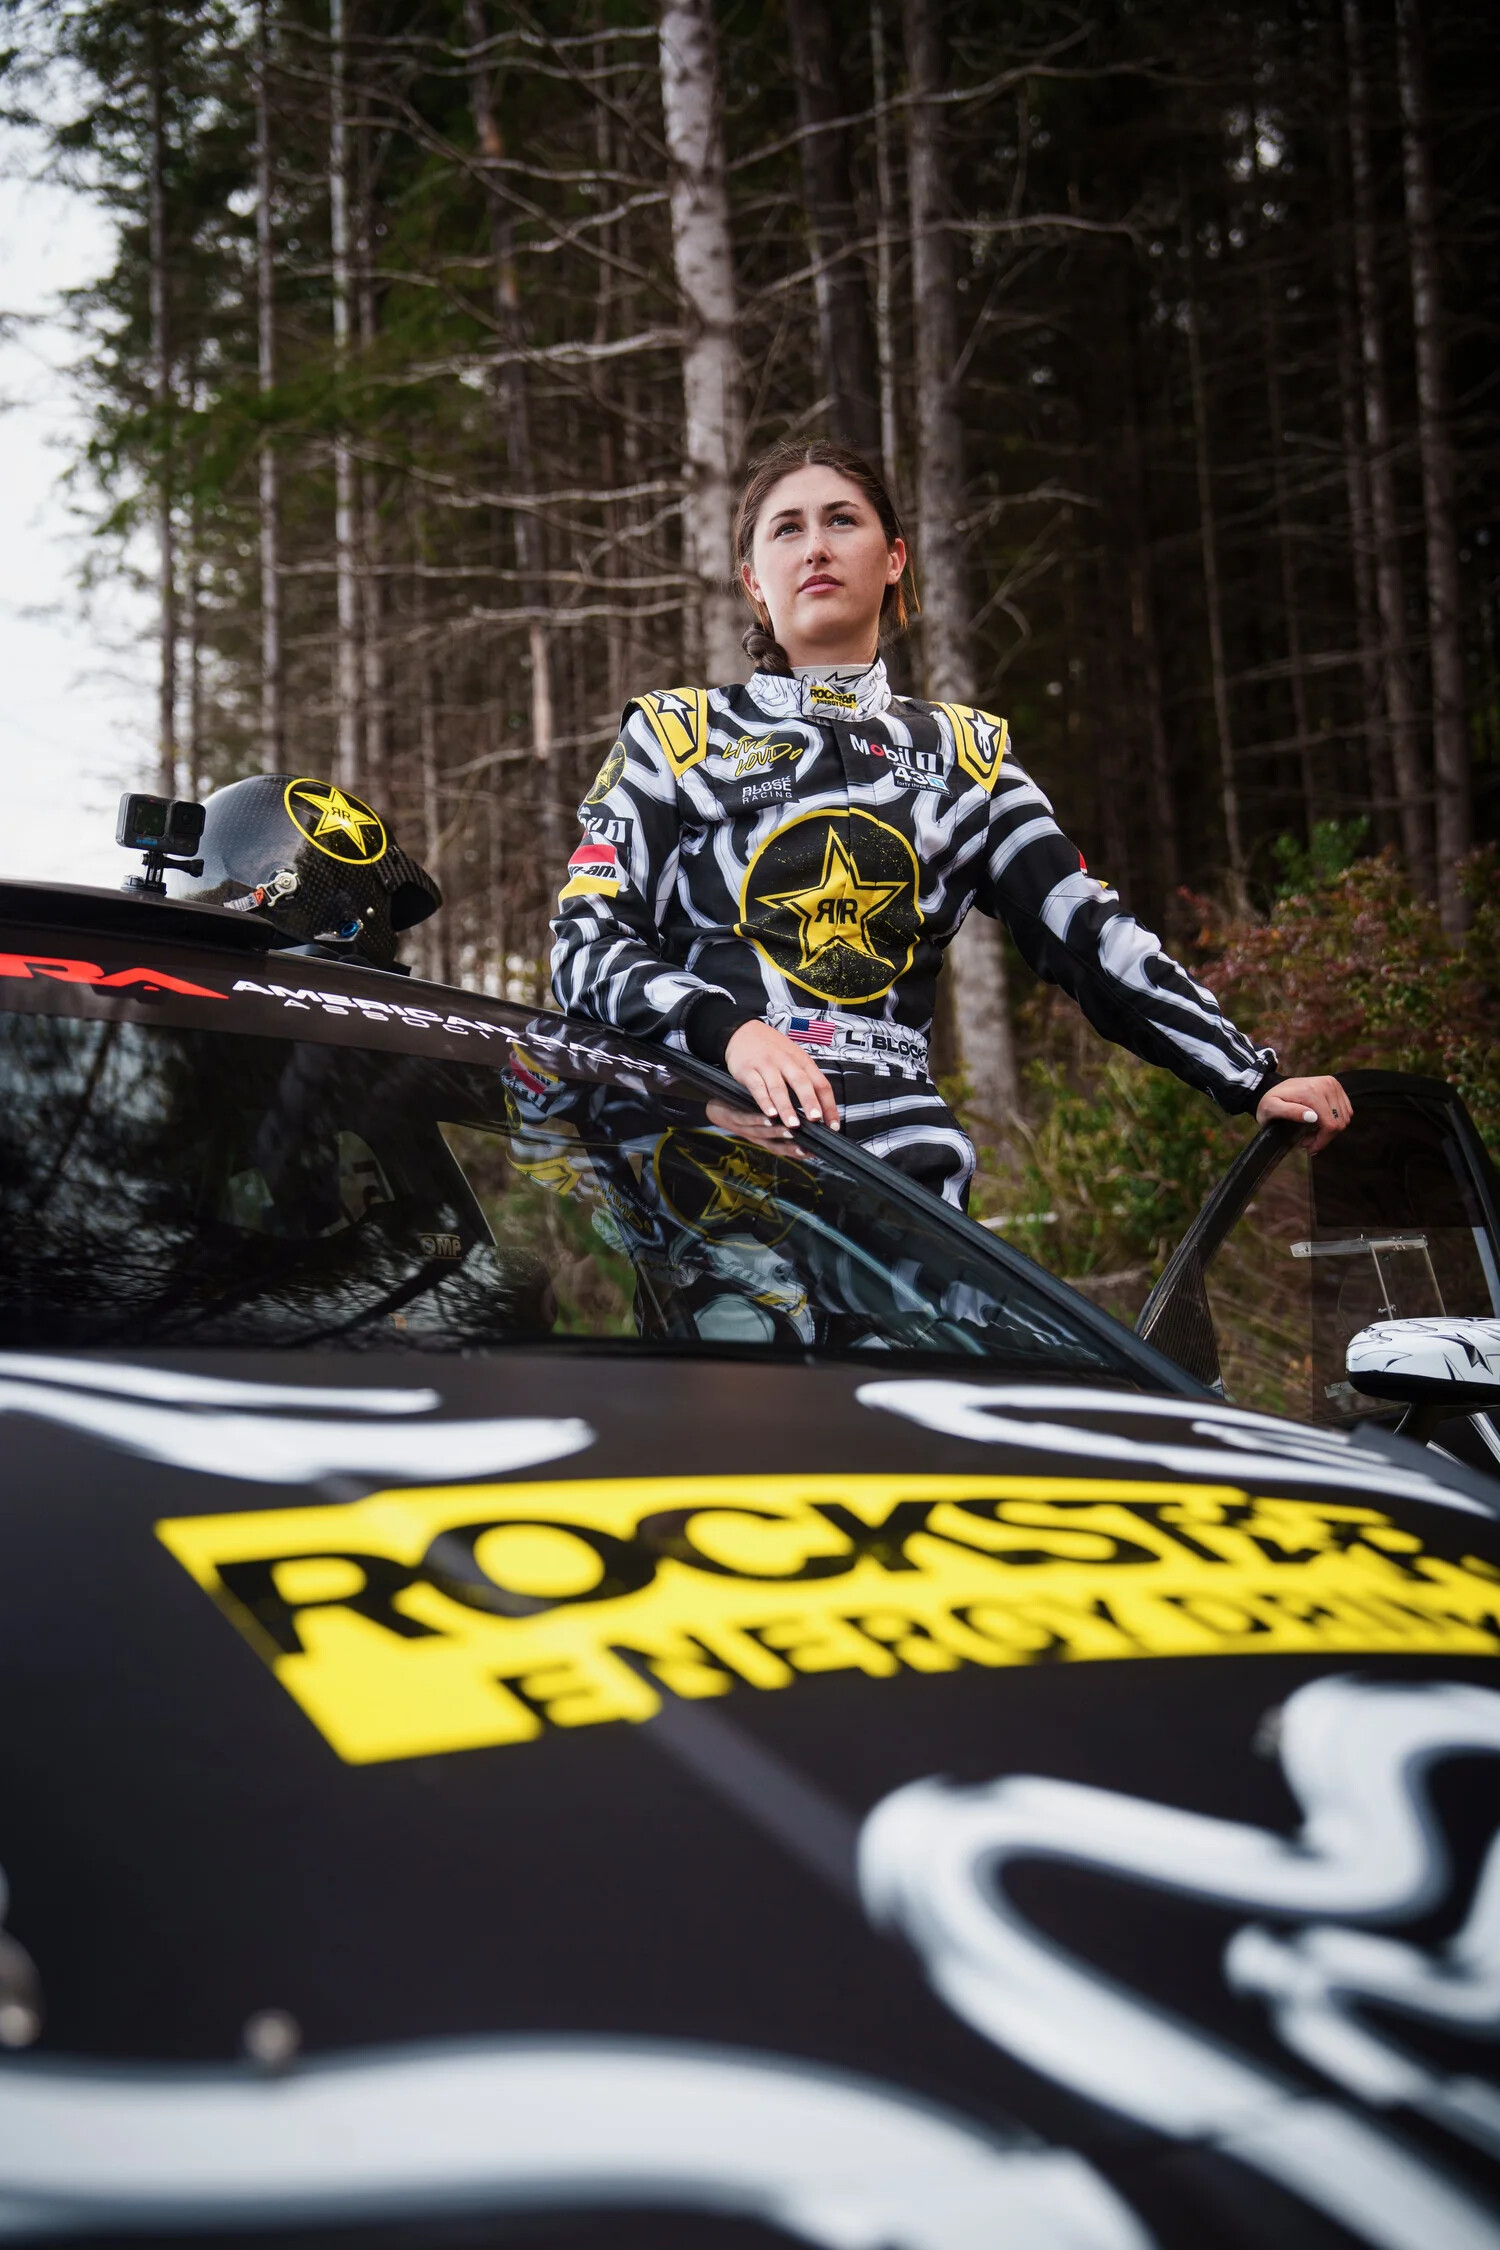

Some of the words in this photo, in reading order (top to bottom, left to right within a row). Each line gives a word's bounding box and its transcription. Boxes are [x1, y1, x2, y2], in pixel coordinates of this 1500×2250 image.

[849, 733, 912, 767] Mobil
[742, 790, 793, 805] RACING
[232, 980, 519, 1038] AMERICAN
[846, 1030, 866, 1047] L.
[871, 1034, 929, 1063] BLOCK
